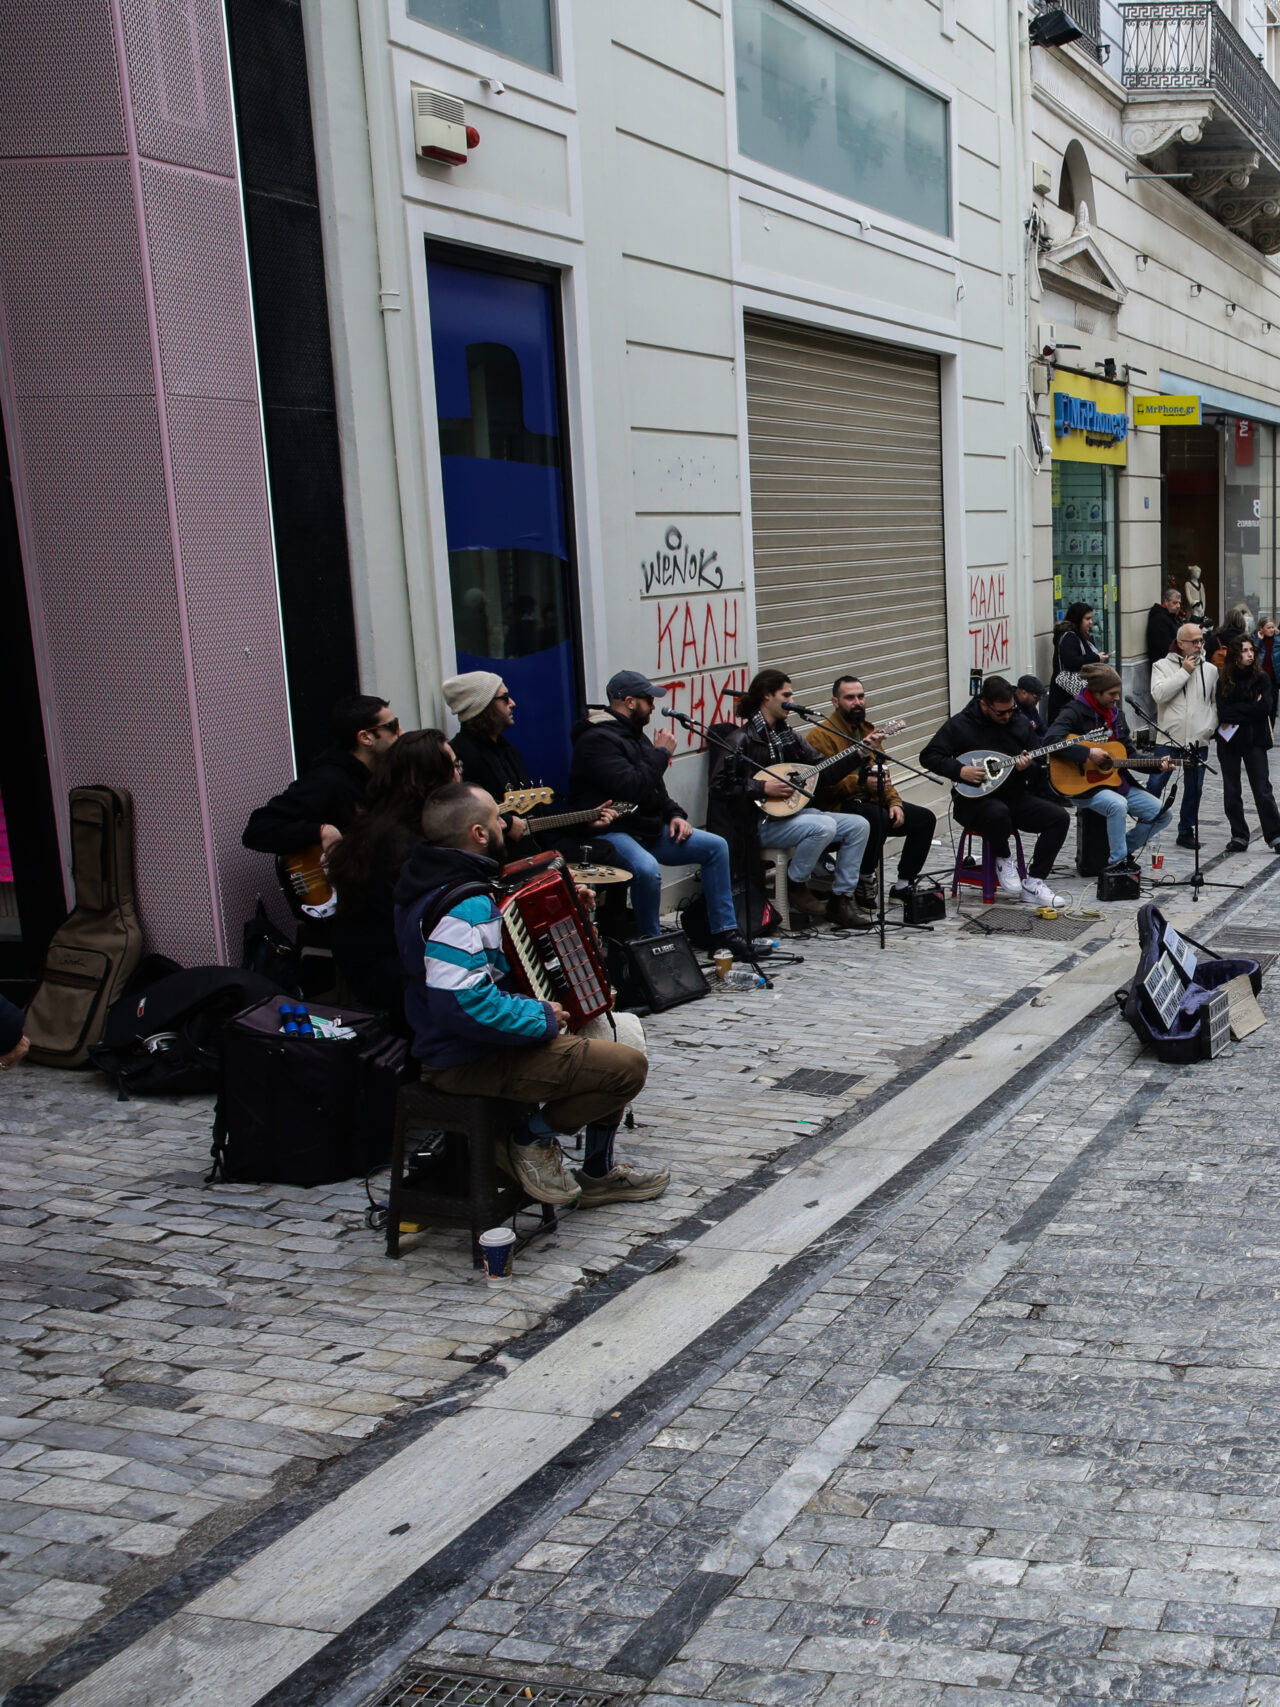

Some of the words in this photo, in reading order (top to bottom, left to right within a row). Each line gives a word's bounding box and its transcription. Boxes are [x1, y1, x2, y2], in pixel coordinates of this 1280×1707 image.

[1146, 405, 1195, 414] MrPhone.gr
[657, 598, 738, 673] ΚΑΛΗ
[652, 943, 675, 956] CUBE
